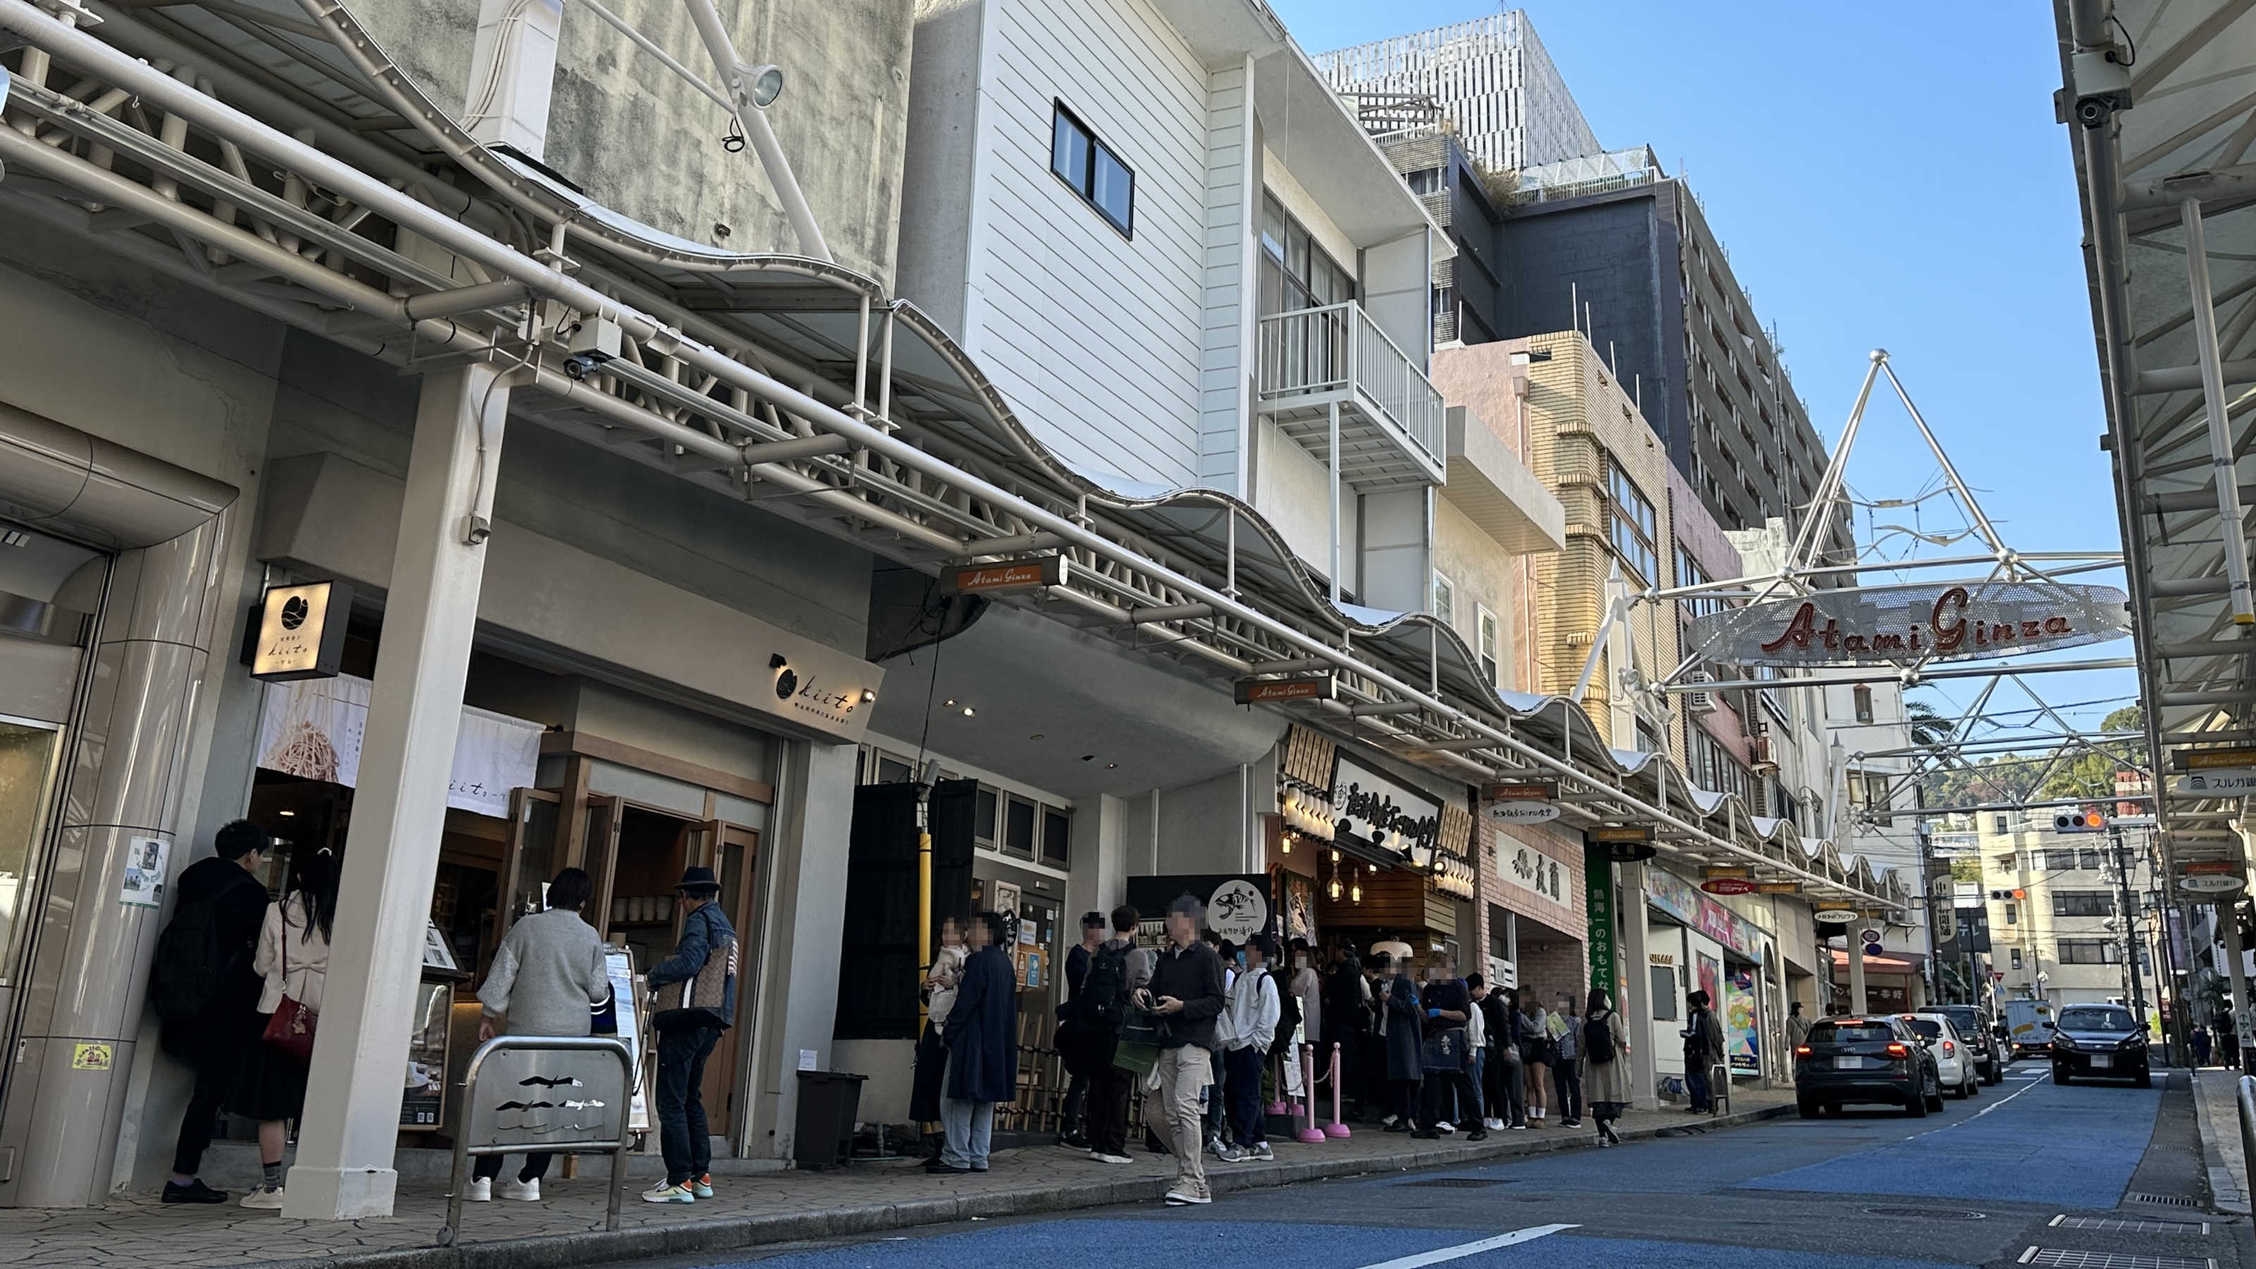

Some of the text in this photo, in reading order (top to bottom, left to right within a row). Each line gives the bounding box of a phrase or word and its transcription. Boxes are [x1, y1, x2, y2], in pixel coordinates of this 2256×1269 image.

[967, 568, 1032, 586] Atami Ginza
[1761, 586, 2073, 654] Atami Ginza
[798, 674, 854, 713] kiito
[1592, 888, 1609, 991] 熱海一のおもてな
